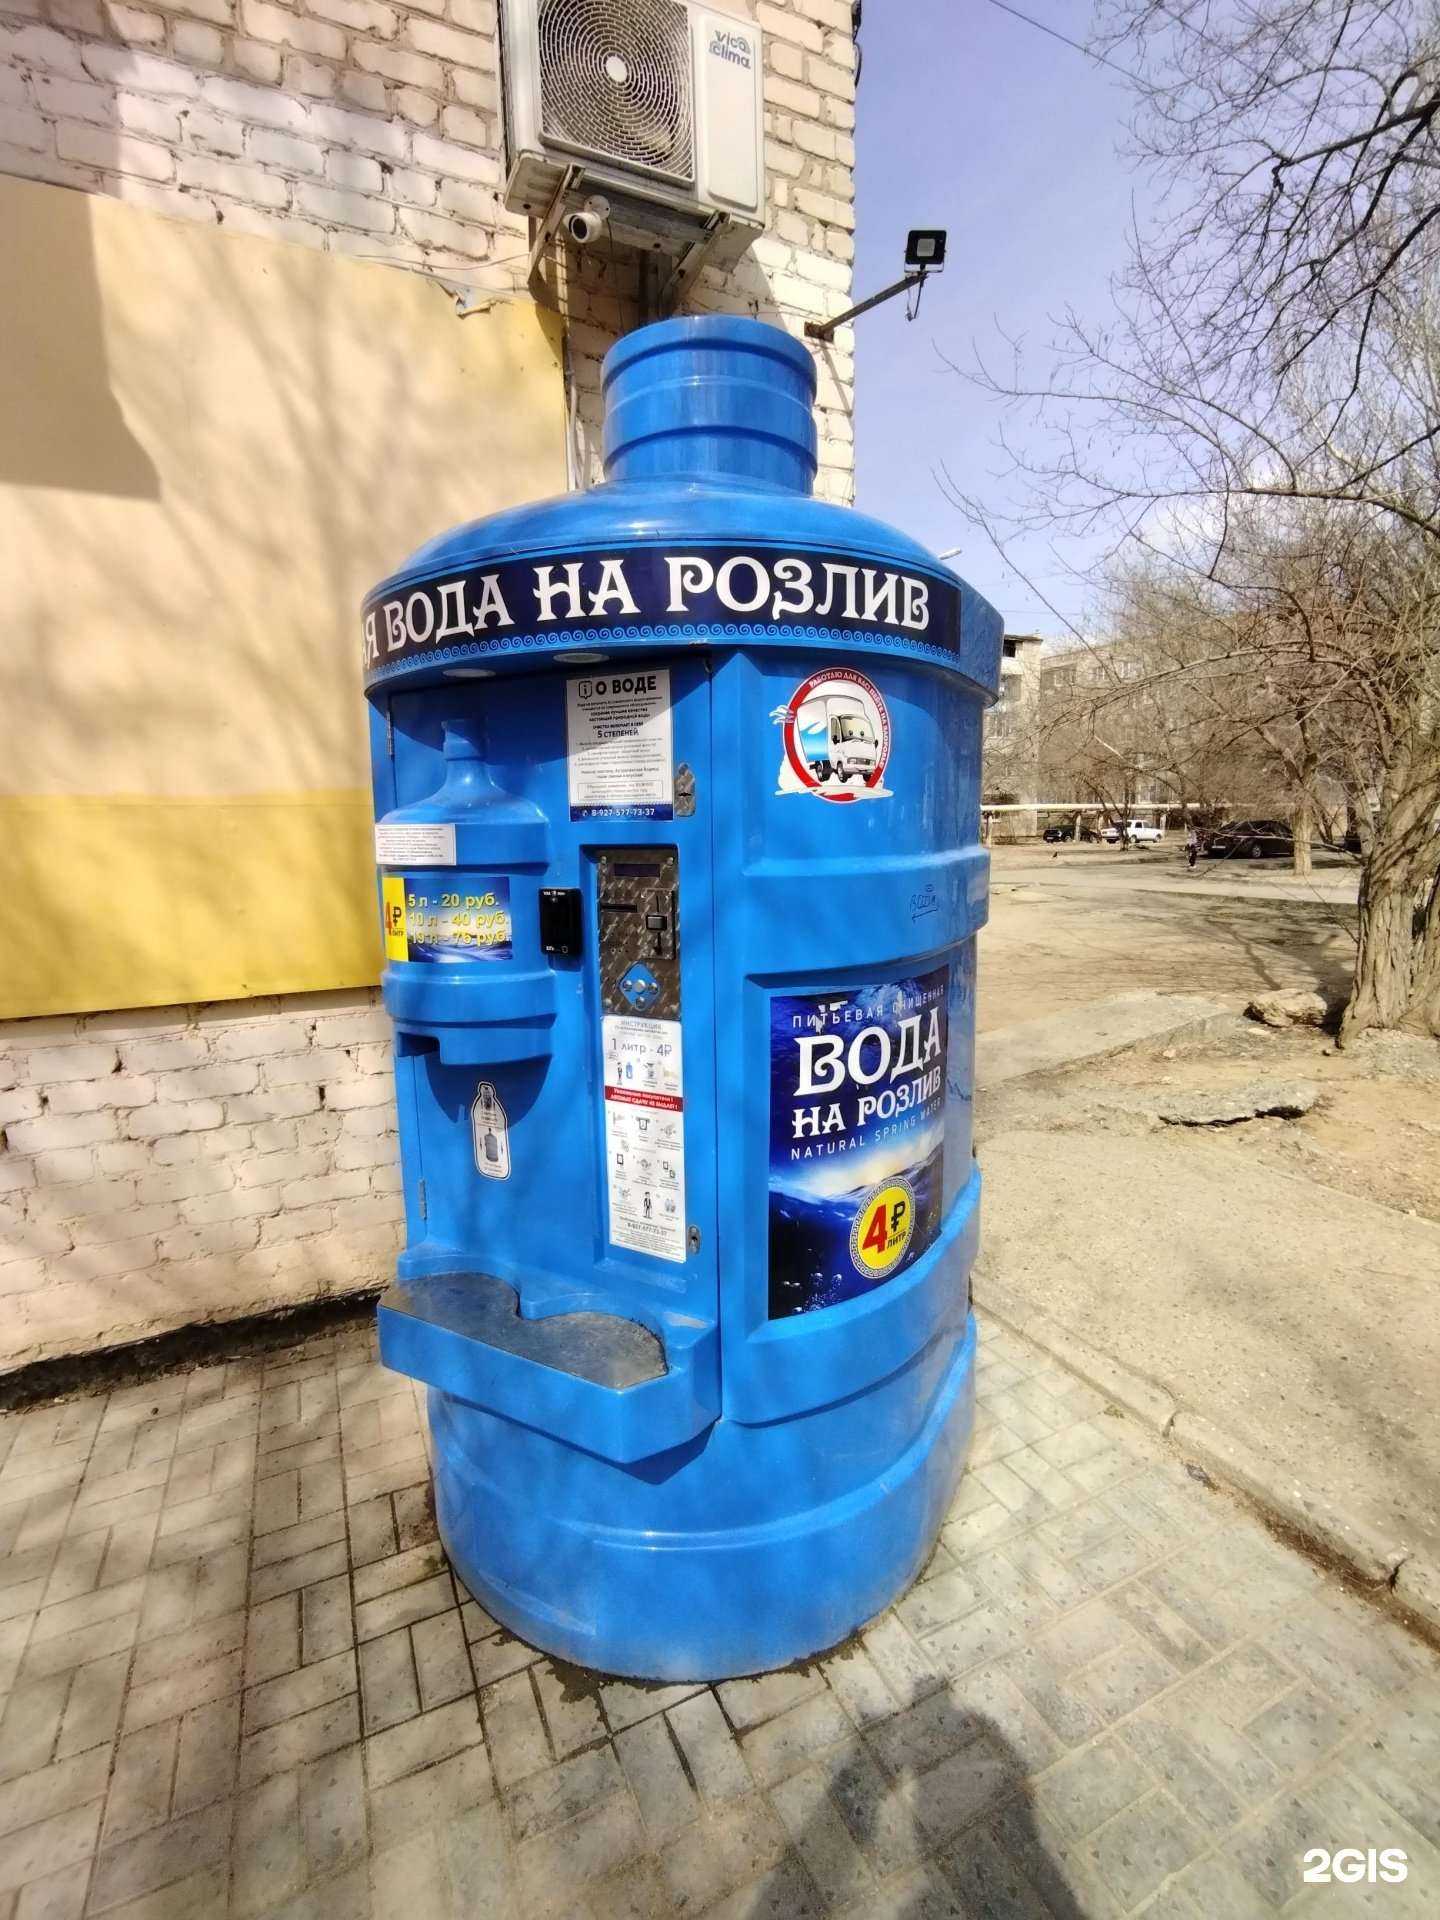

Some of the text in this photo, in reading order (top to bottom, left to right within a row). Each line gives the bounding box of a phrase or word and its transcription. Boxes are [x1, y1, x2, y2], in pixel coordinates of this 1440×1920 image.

[383, 574, 516, 653] ВОДА
[533, 560, 637, 622] НА
[664, 555, 932, 631] РОЗЛИВ
[596, 675, 657, 695] О ВОДЕ
[597, 728, 640, 739] 5 СТЕПЕНЕЙ
[408, 893, 417, 907] 5
[441, 893, 461, 908] 20
[466, 892, 500, 910] руб.
[409, 912, 425, 927] 10
[451, 911, 471, 927] 40
[793, 1005, 884, 1029] ПИТЬЕВАЯ
[611, 1038, 617, 1051] 1
[621, 1043, 648, 1055] литр
[793, 1006, 942, 1098] ВОДА
[792, 1065, 942, 1139] НА РОЗЛИВ
[791, 1135, 865, 1161] NATURAL
[874, 1117, 917, 1142] SPRING
